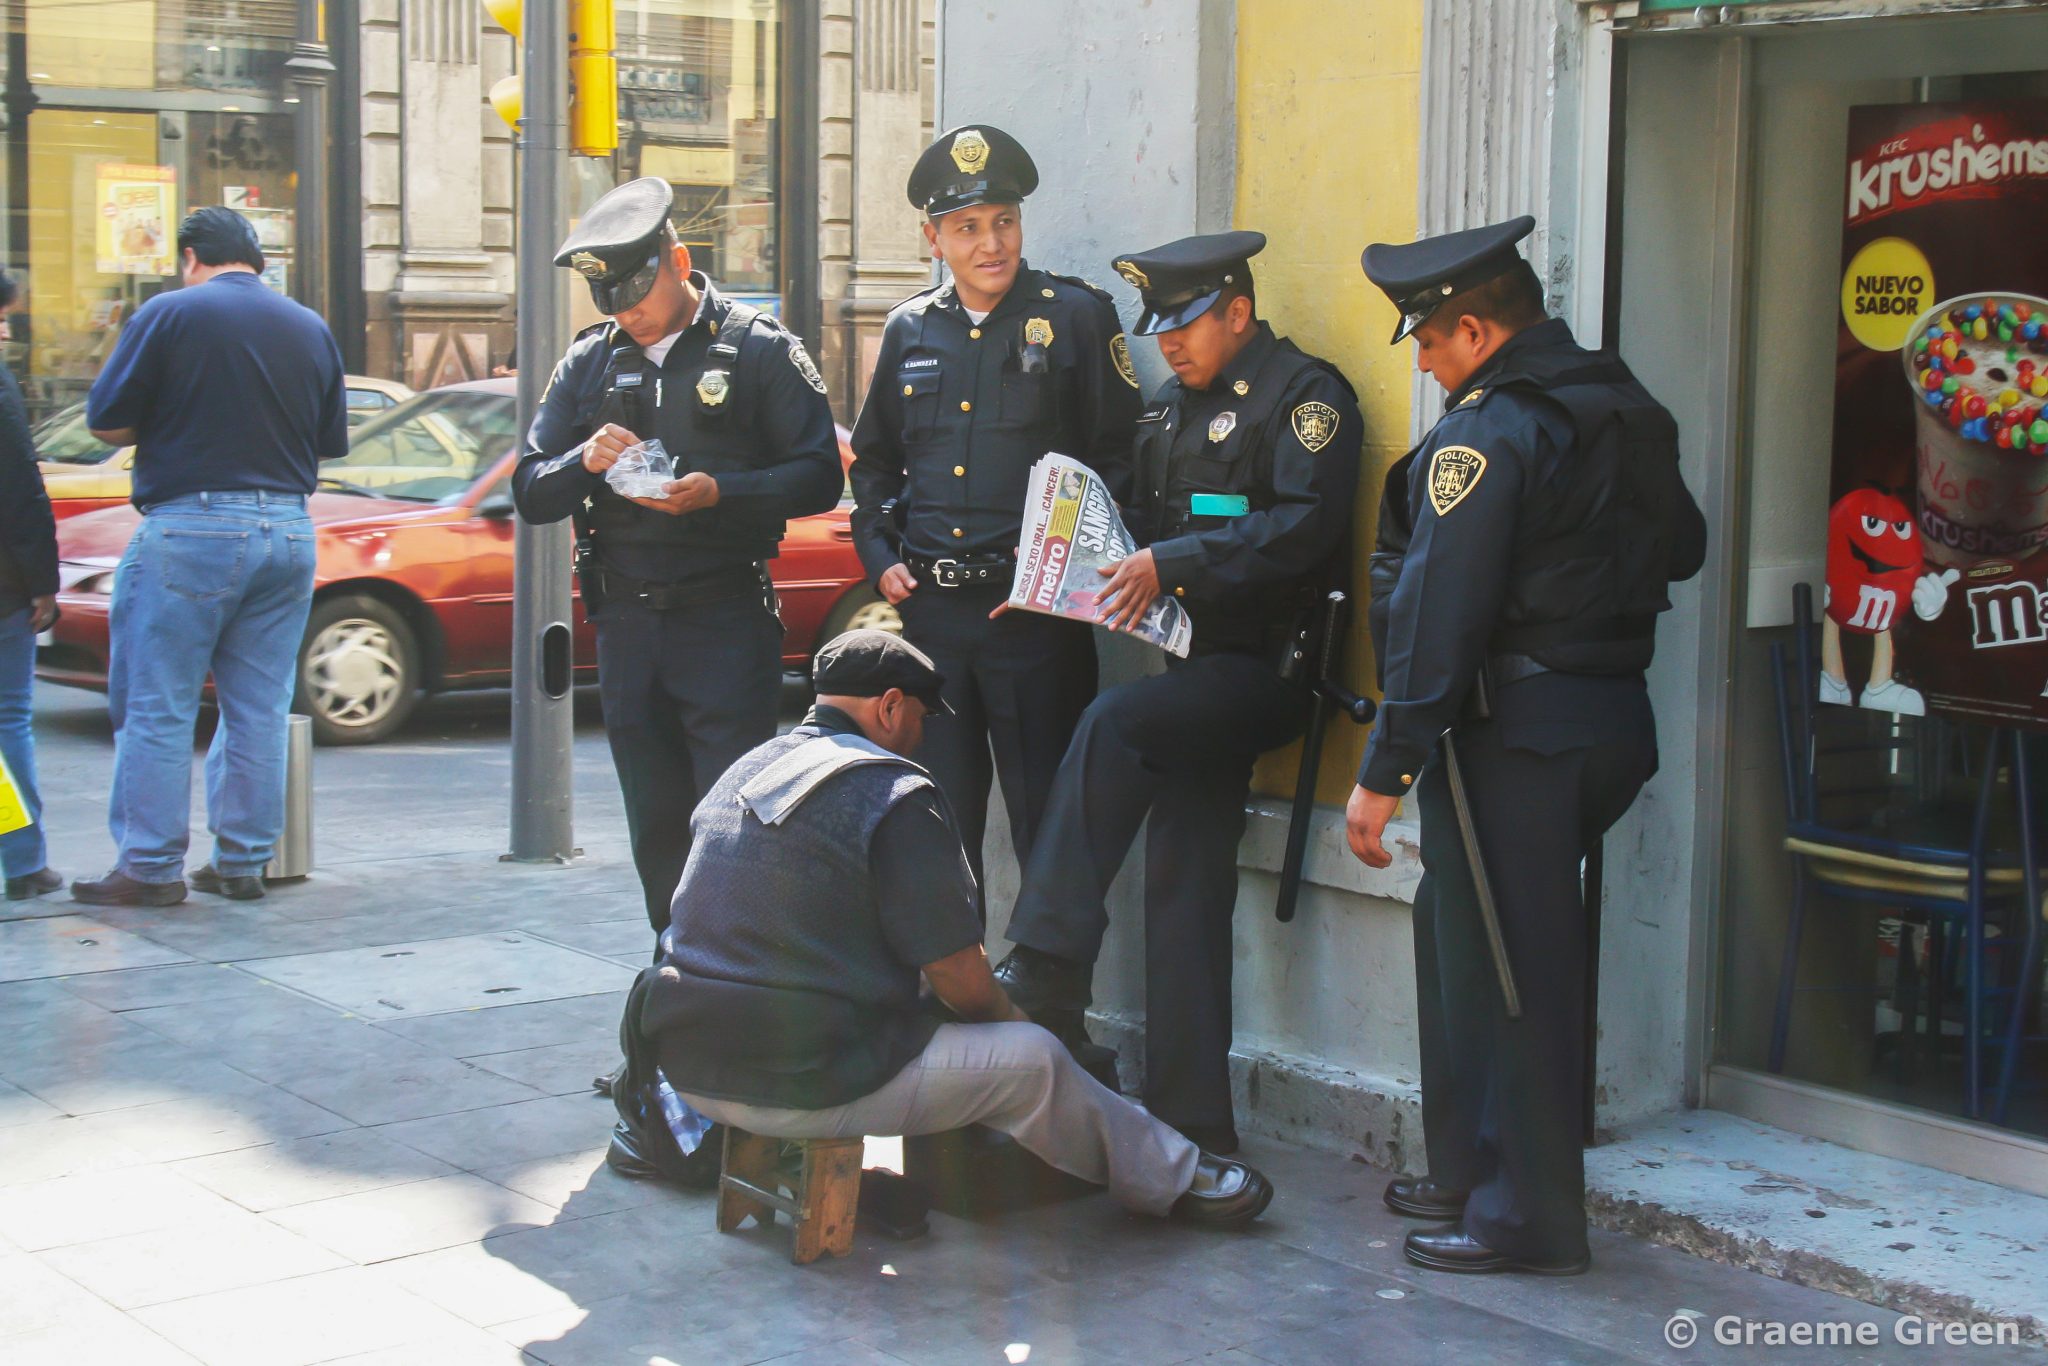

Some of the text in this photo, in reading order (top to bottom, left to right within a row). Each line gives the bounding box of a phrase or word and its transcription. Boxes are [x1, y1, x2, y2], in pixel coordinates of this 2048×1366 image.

[1879, 138, 1908, 157] KFC
[1855, 276, 1923, 294] NUEVO
[1855, 296, 1918, 315] SABOR
[1297, 405, 1336, 421] POLICIA
[1438, 451, 1479, 469] POLICIA
[1025, 548, 1040, 573] SEXO
[1035, 543, 1065, 606] metro
